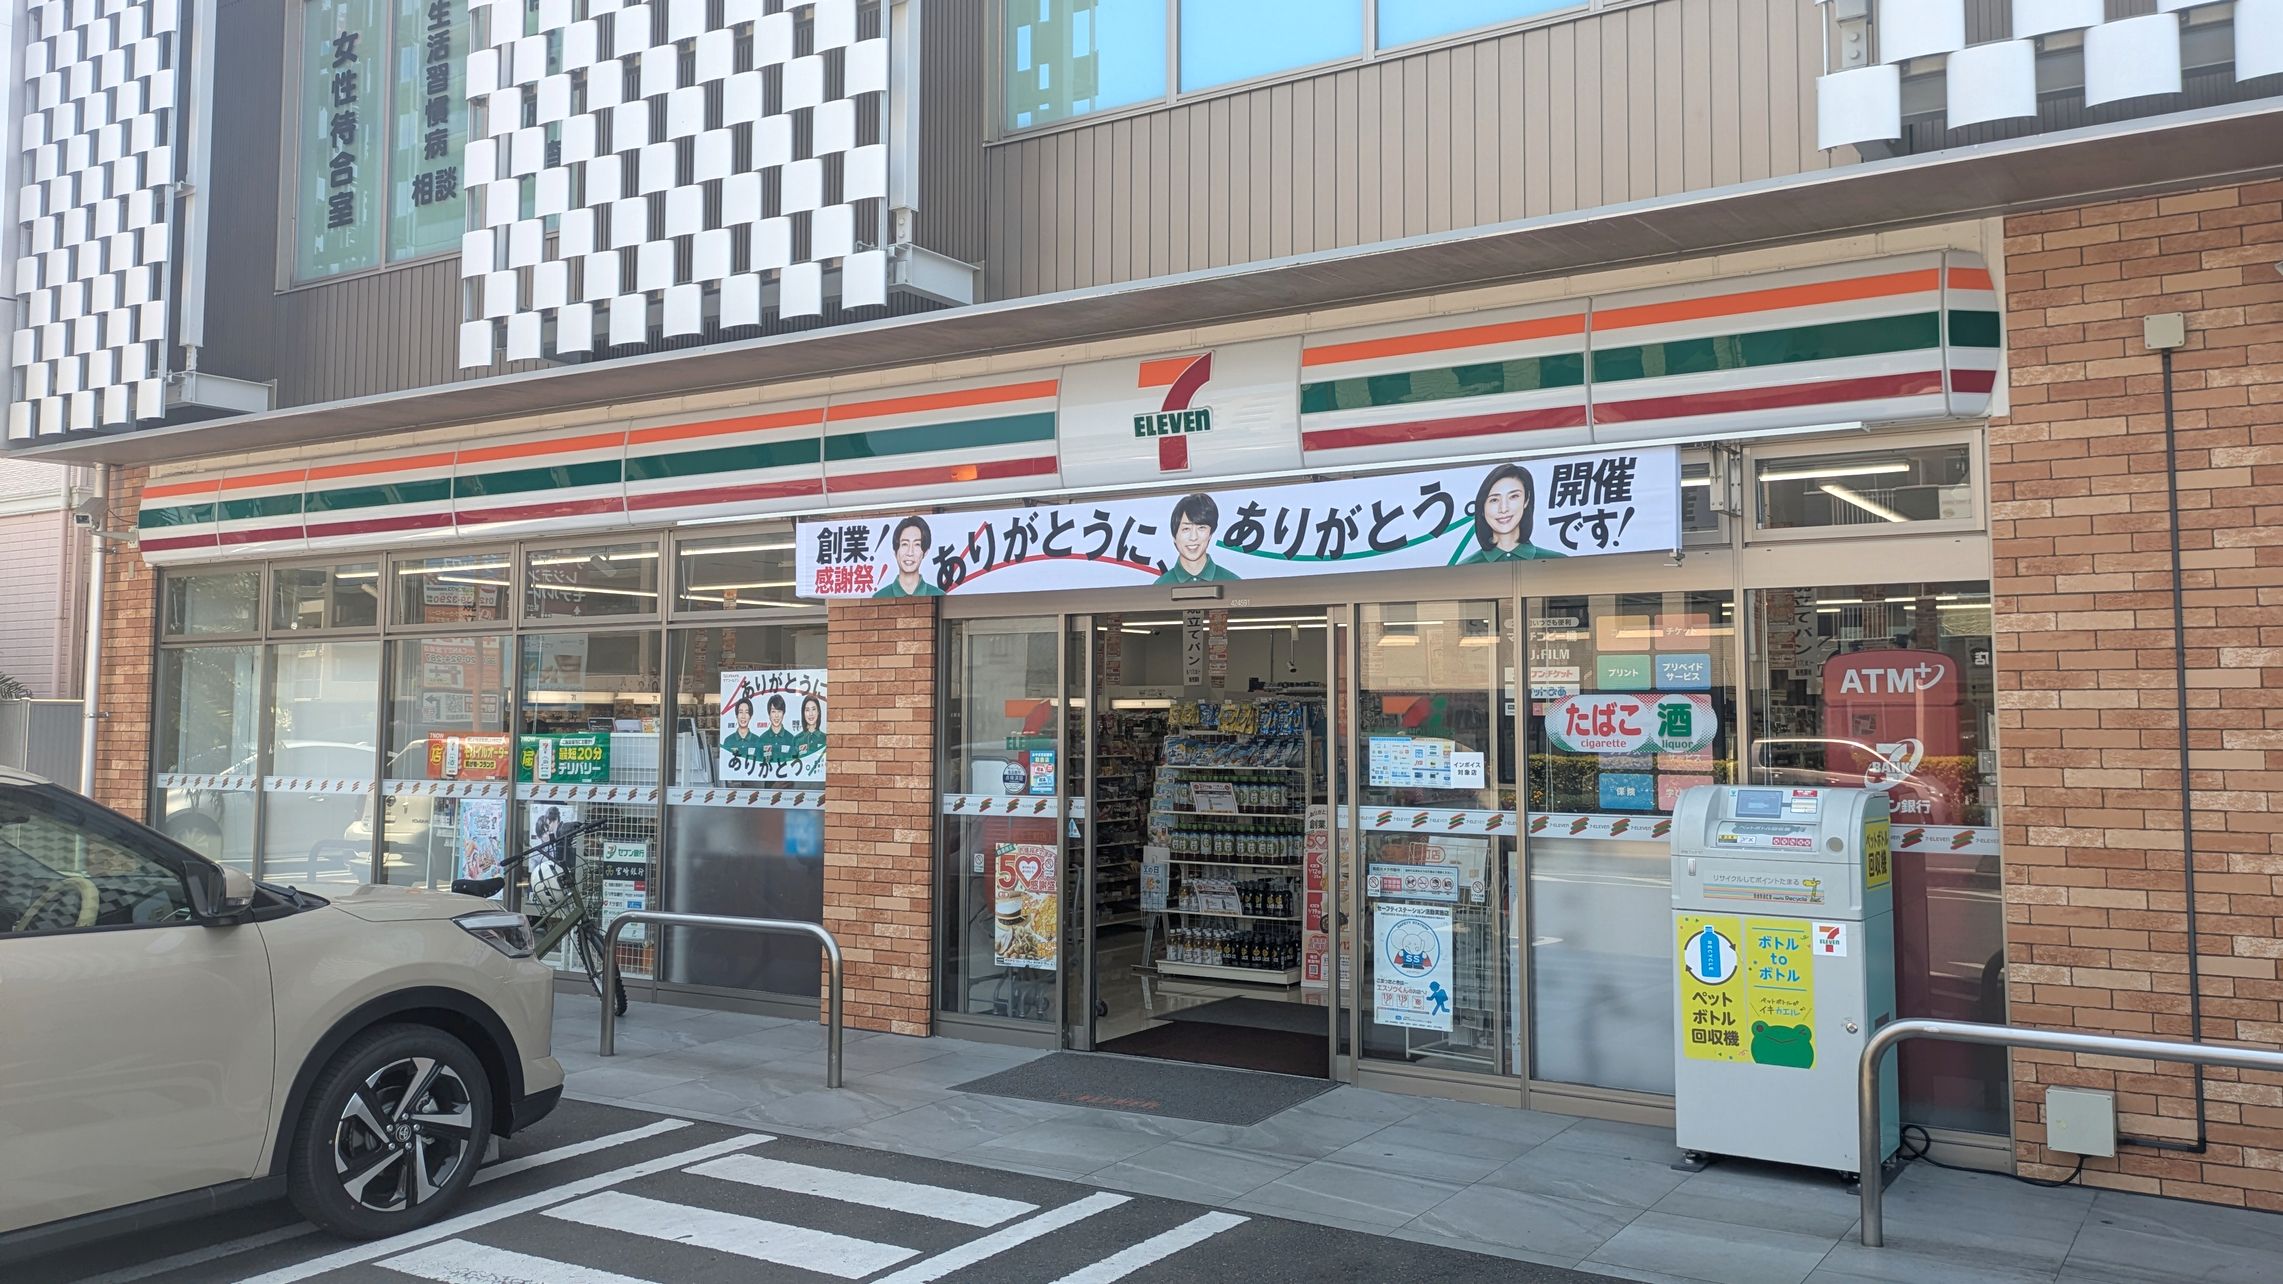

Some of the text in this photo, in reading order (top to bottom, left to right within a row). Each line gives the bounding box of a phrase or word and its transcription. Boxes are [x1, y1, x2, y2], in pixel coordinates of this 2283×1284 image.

[424, 0, 451, 160] 生活習慣病
[327, 31, 359, 229] 女性待合室
[411, 166, 457, 207] 相談
[1133, 408, 1211, 437] ELEVEN
[1548, 456, 1637, 509] 開催
[1608, 668, 1639, 677] プリント
[1662, 663, 1704, 672] プリペイド
[1665, 672, 1700, 681] サービス
[1565, 701, 1642, 737] たばこ
[1657, 702, 1692, 738] 酒
[1580, 738, 1627, 748] cigarette
[1661, 738, 1694, 750] liquor
[558, 746, 603, 761] 最短20分
[558, 762, 602, 775] デリバリー
[1616, 788, 1636, 797] 保険
[1867, 850, 1888, 878] 回収機
[1713, 874, 1800, 886] リサイクルしてポイントたまる
[1757, 935, 1799, 951] ボトル
[1405, 954, 1421, 963] SS
[1770, 952, 1788, 966] to
[1759, 966, 1801, 982] ボトル
[1691, 991, 1733, 1007] ペット
[1692, 1009, 1736, 1026] ボトル
[1691, 1028, 1740, 1046] 回収機
